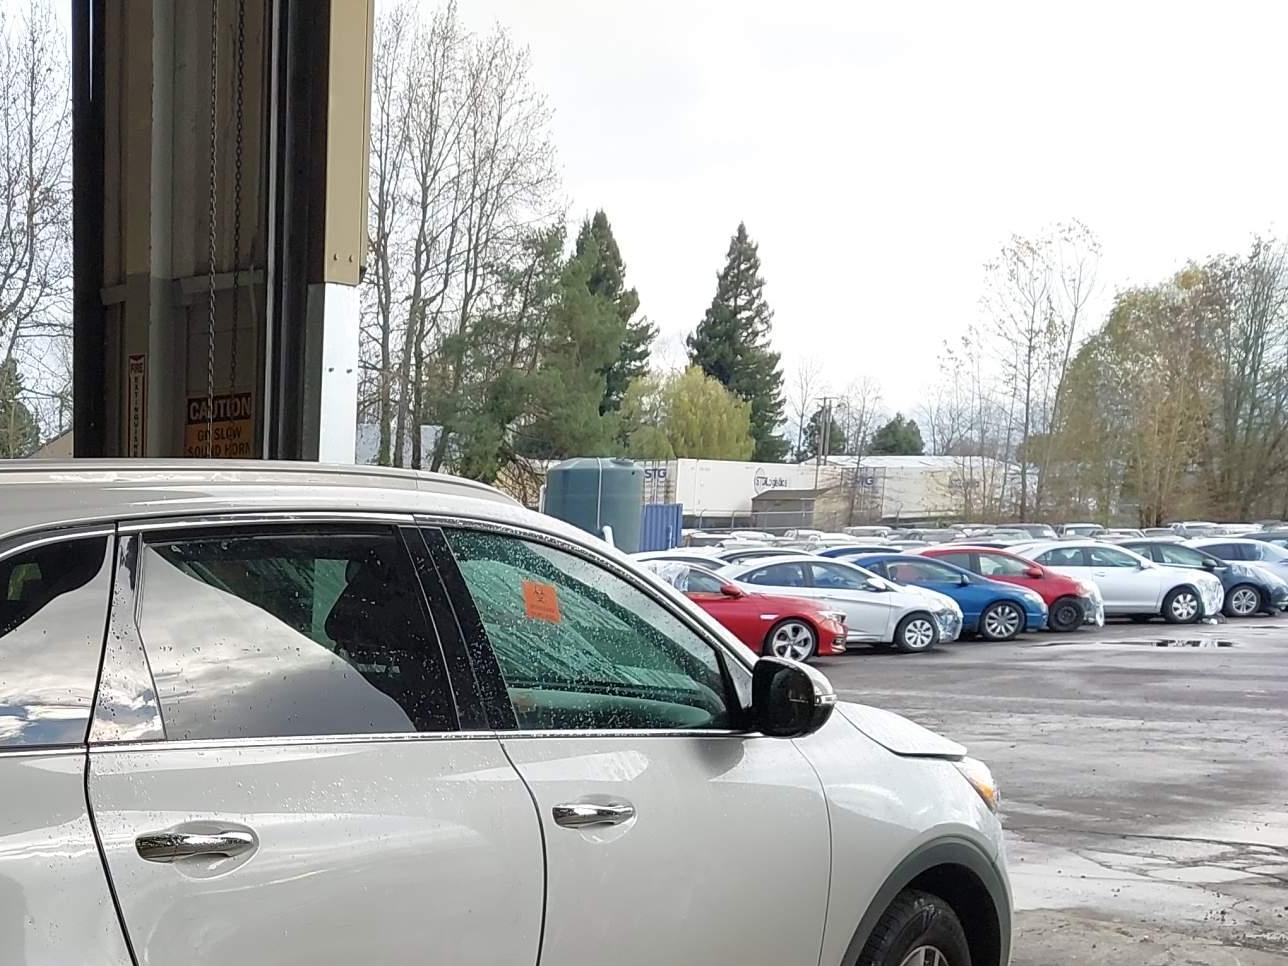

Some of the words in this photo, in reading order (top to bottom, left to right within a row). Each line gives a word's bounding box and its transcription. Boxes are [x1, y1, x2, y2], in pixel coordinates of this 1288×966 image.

[189, 396, 251, 421] CAUTION
[214, 426, 242, 441] SLOW
[188, 444, 221, 457] SOUND
[224, 442, 250, 456] HORN
[644, 468, 667, 479] STG
